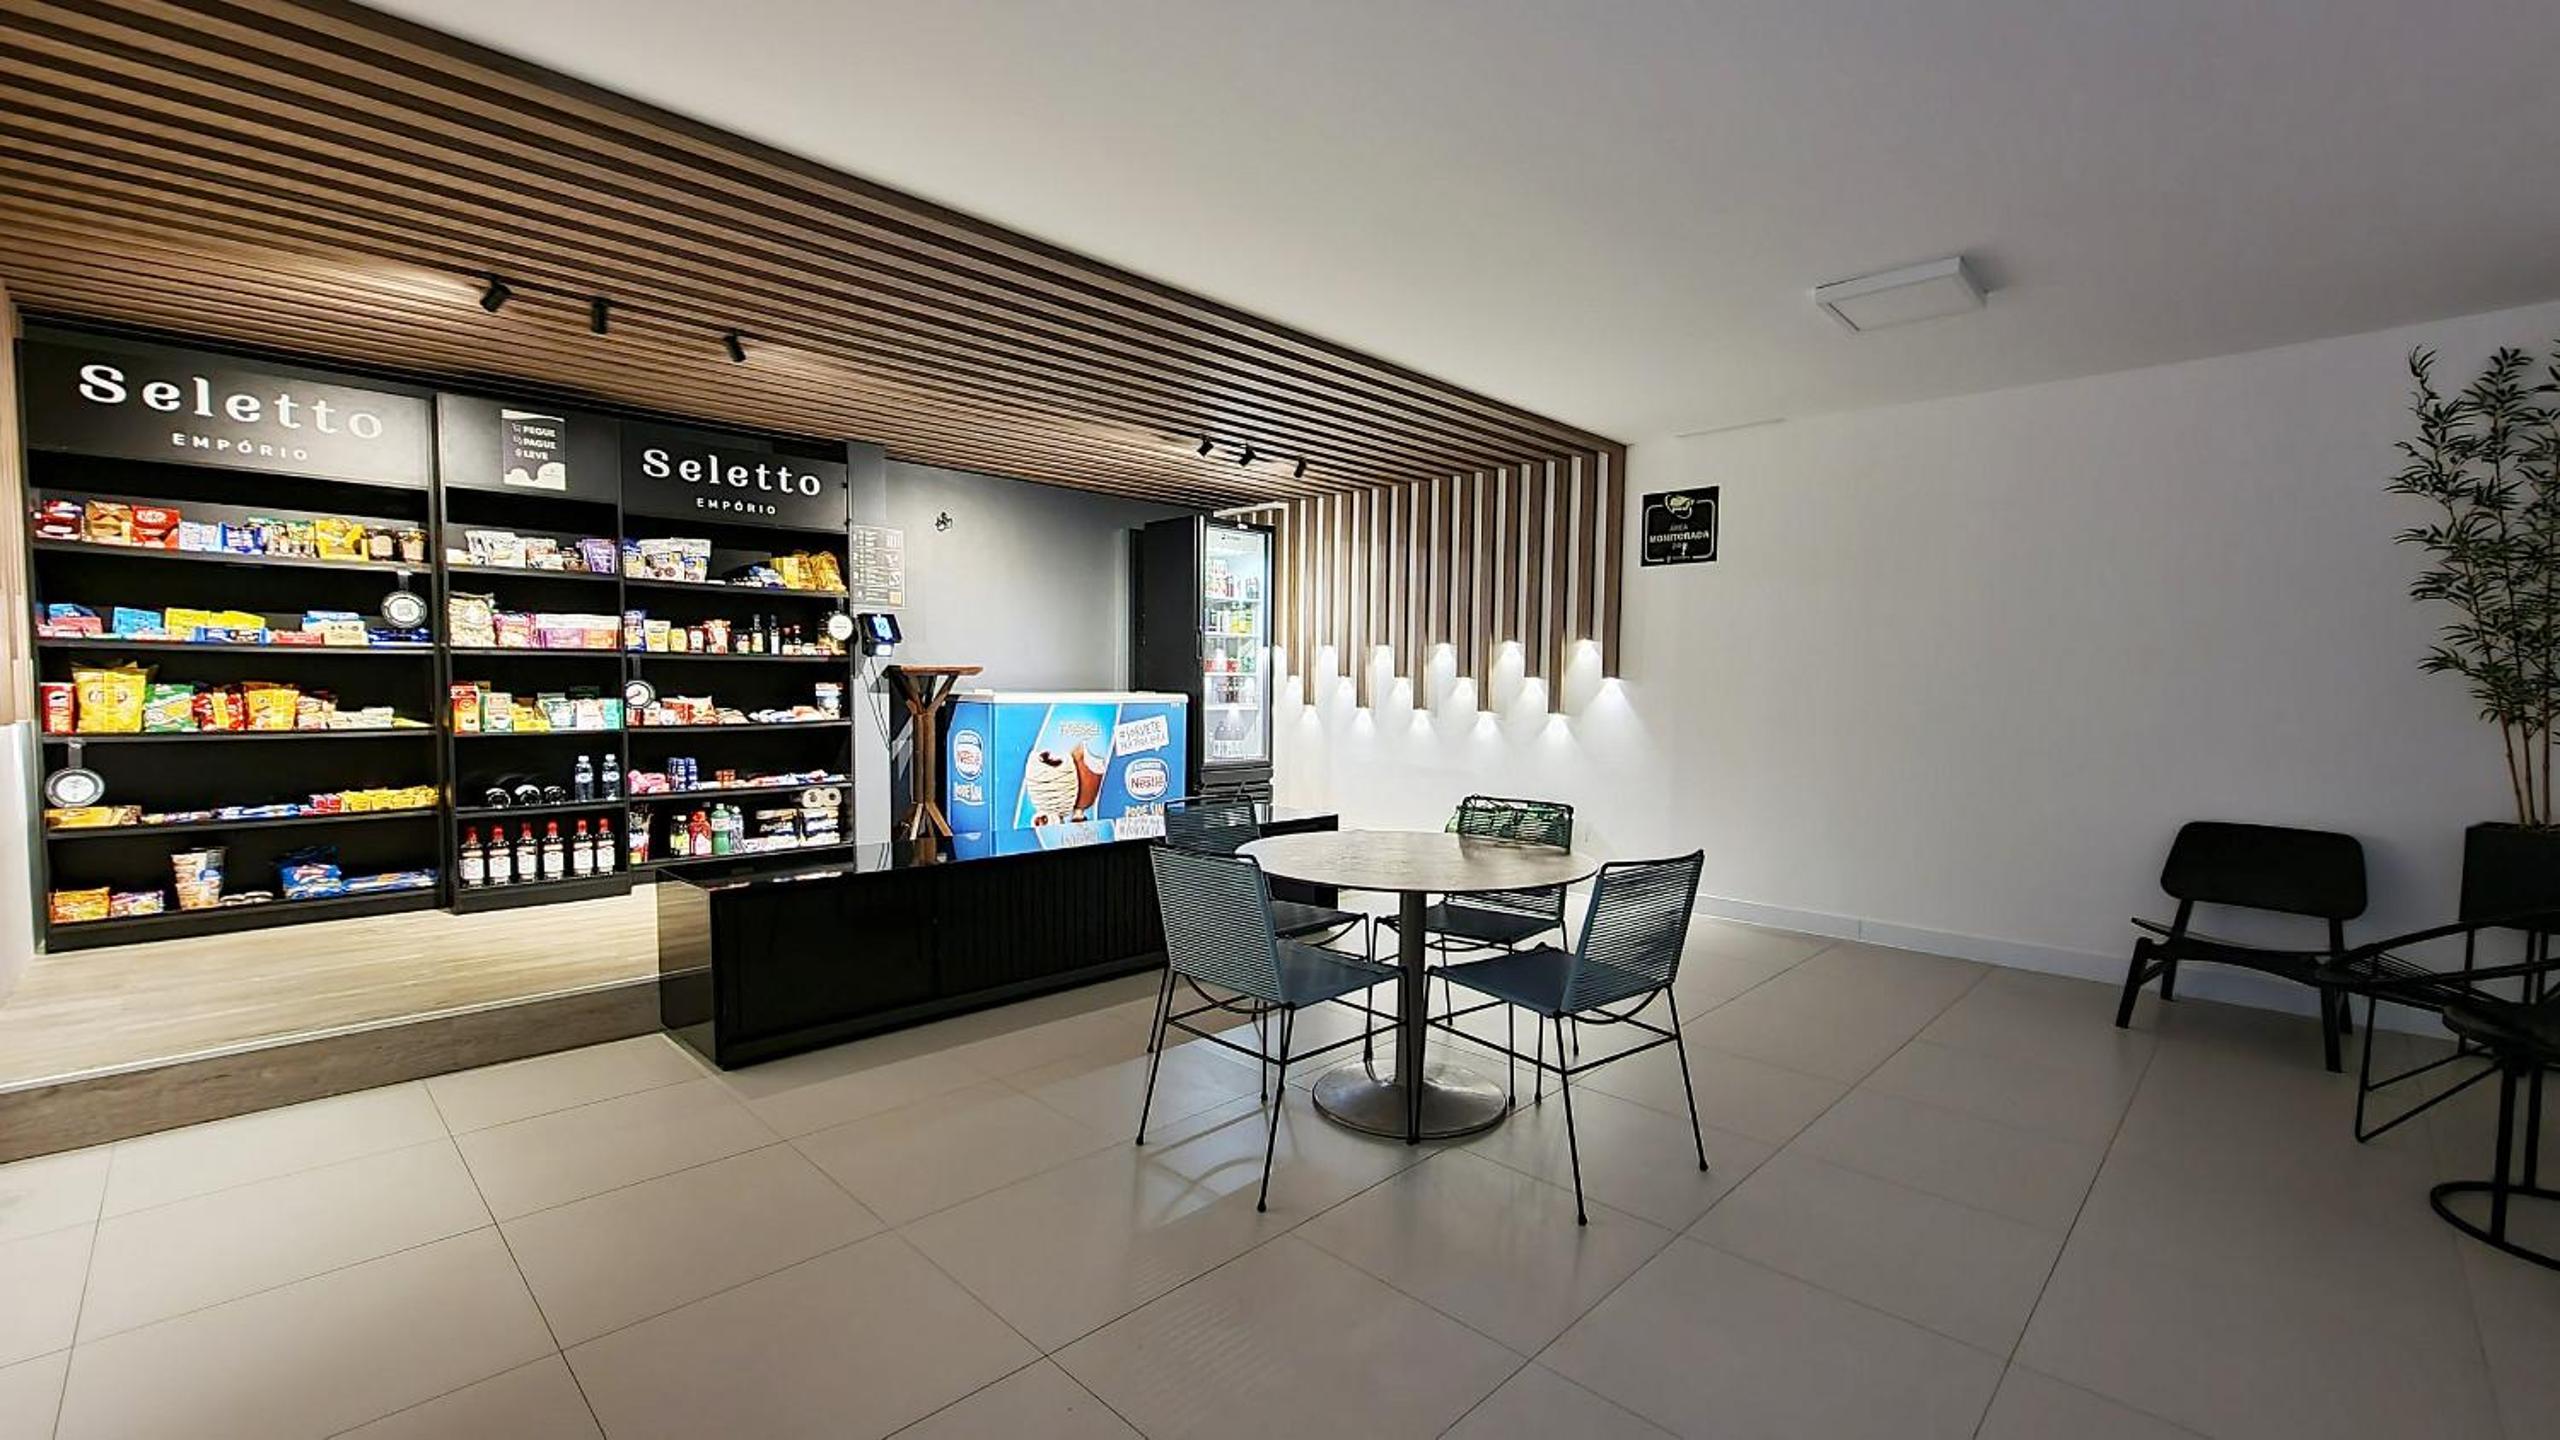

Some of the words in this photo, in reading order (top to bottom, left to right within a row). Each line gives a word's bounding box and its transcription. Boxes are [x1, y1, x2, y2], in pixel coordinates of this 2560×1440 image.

[79, 364, 383, 439] Seletto
[523, 425, 556, 437] PEGUE
[172, 432, 308, 461] EMPÓRIO
[523, 438, 556, 450] PAGUE
[523, 450, 549, 461] LEVE
[642, 449, 821, 496] Seletto
[696, 498, 776, 515] EMPÓRIO
[1649, 530, 1709, 543] MONITORADA
[1131, 775, 1163, 788] Nestlé
